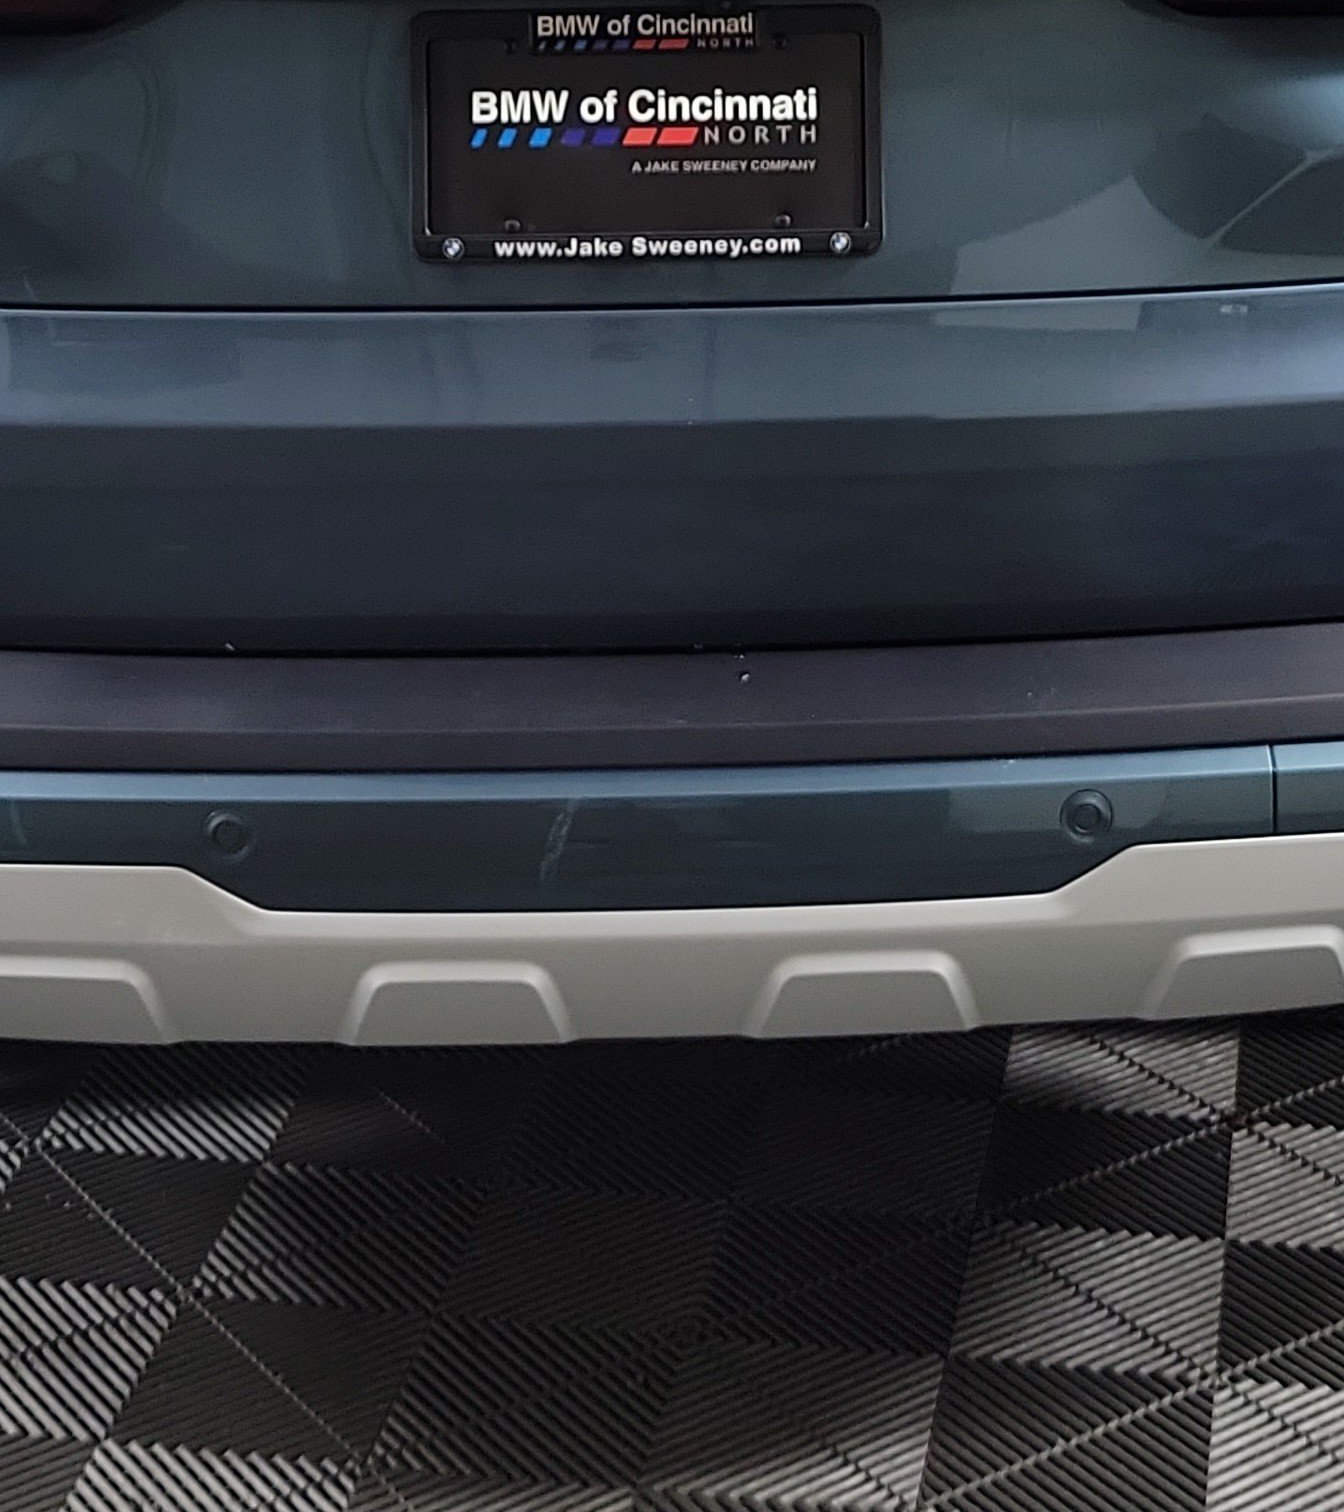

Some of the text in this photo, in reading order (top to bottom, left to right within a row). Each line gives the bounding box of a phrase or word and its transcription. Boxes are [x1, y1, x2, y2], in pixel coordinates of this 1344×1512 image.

[536, 12, 754, 37] BMW of Cincinnati
[471, 87, 817, 123] BMW of Cincinnati
[704, 124, 817, 145] NORTH
[631, 159, 816, 172] A JAKE SWEENEY COMPANY
[495, 237, 801, 257] www.Jake Sweeney.com
